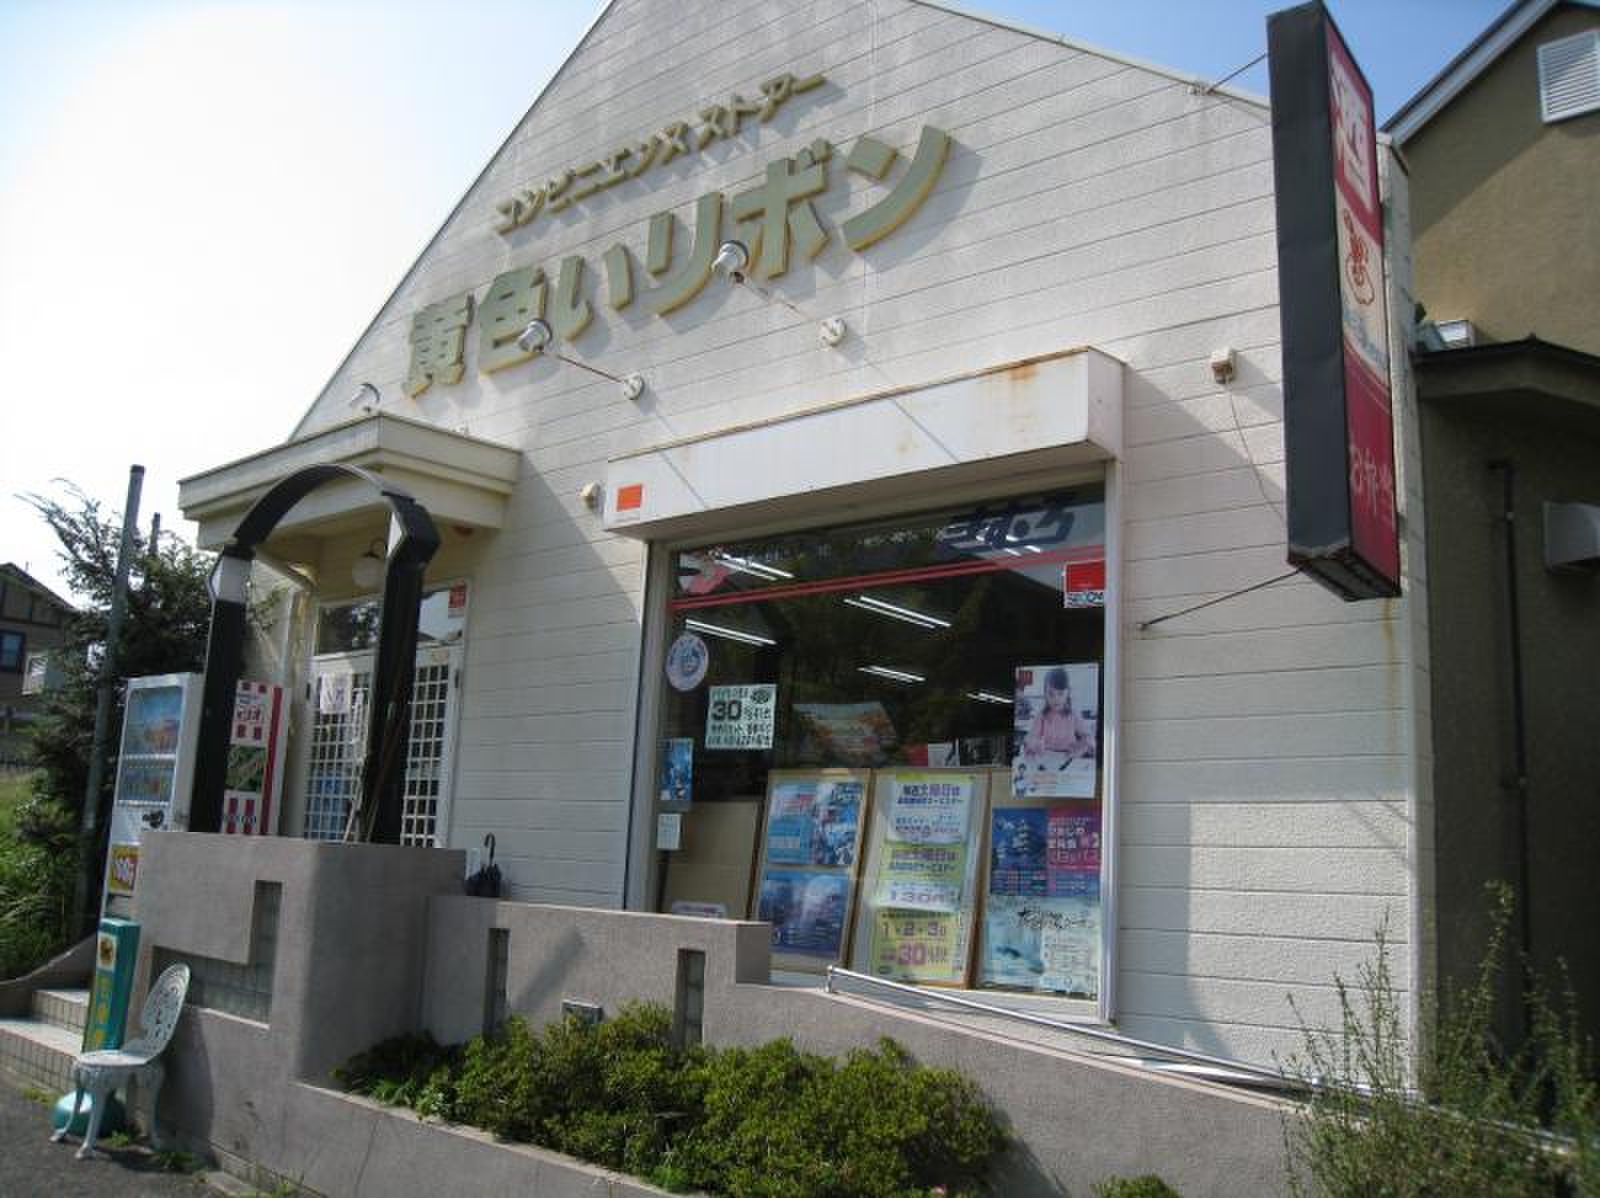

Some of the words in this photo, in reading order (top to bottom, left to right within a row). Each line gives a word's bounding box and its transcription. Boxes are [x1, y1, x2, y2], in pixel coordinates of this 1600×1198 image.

[403, 125, 951, 399] 黄色いリボン
